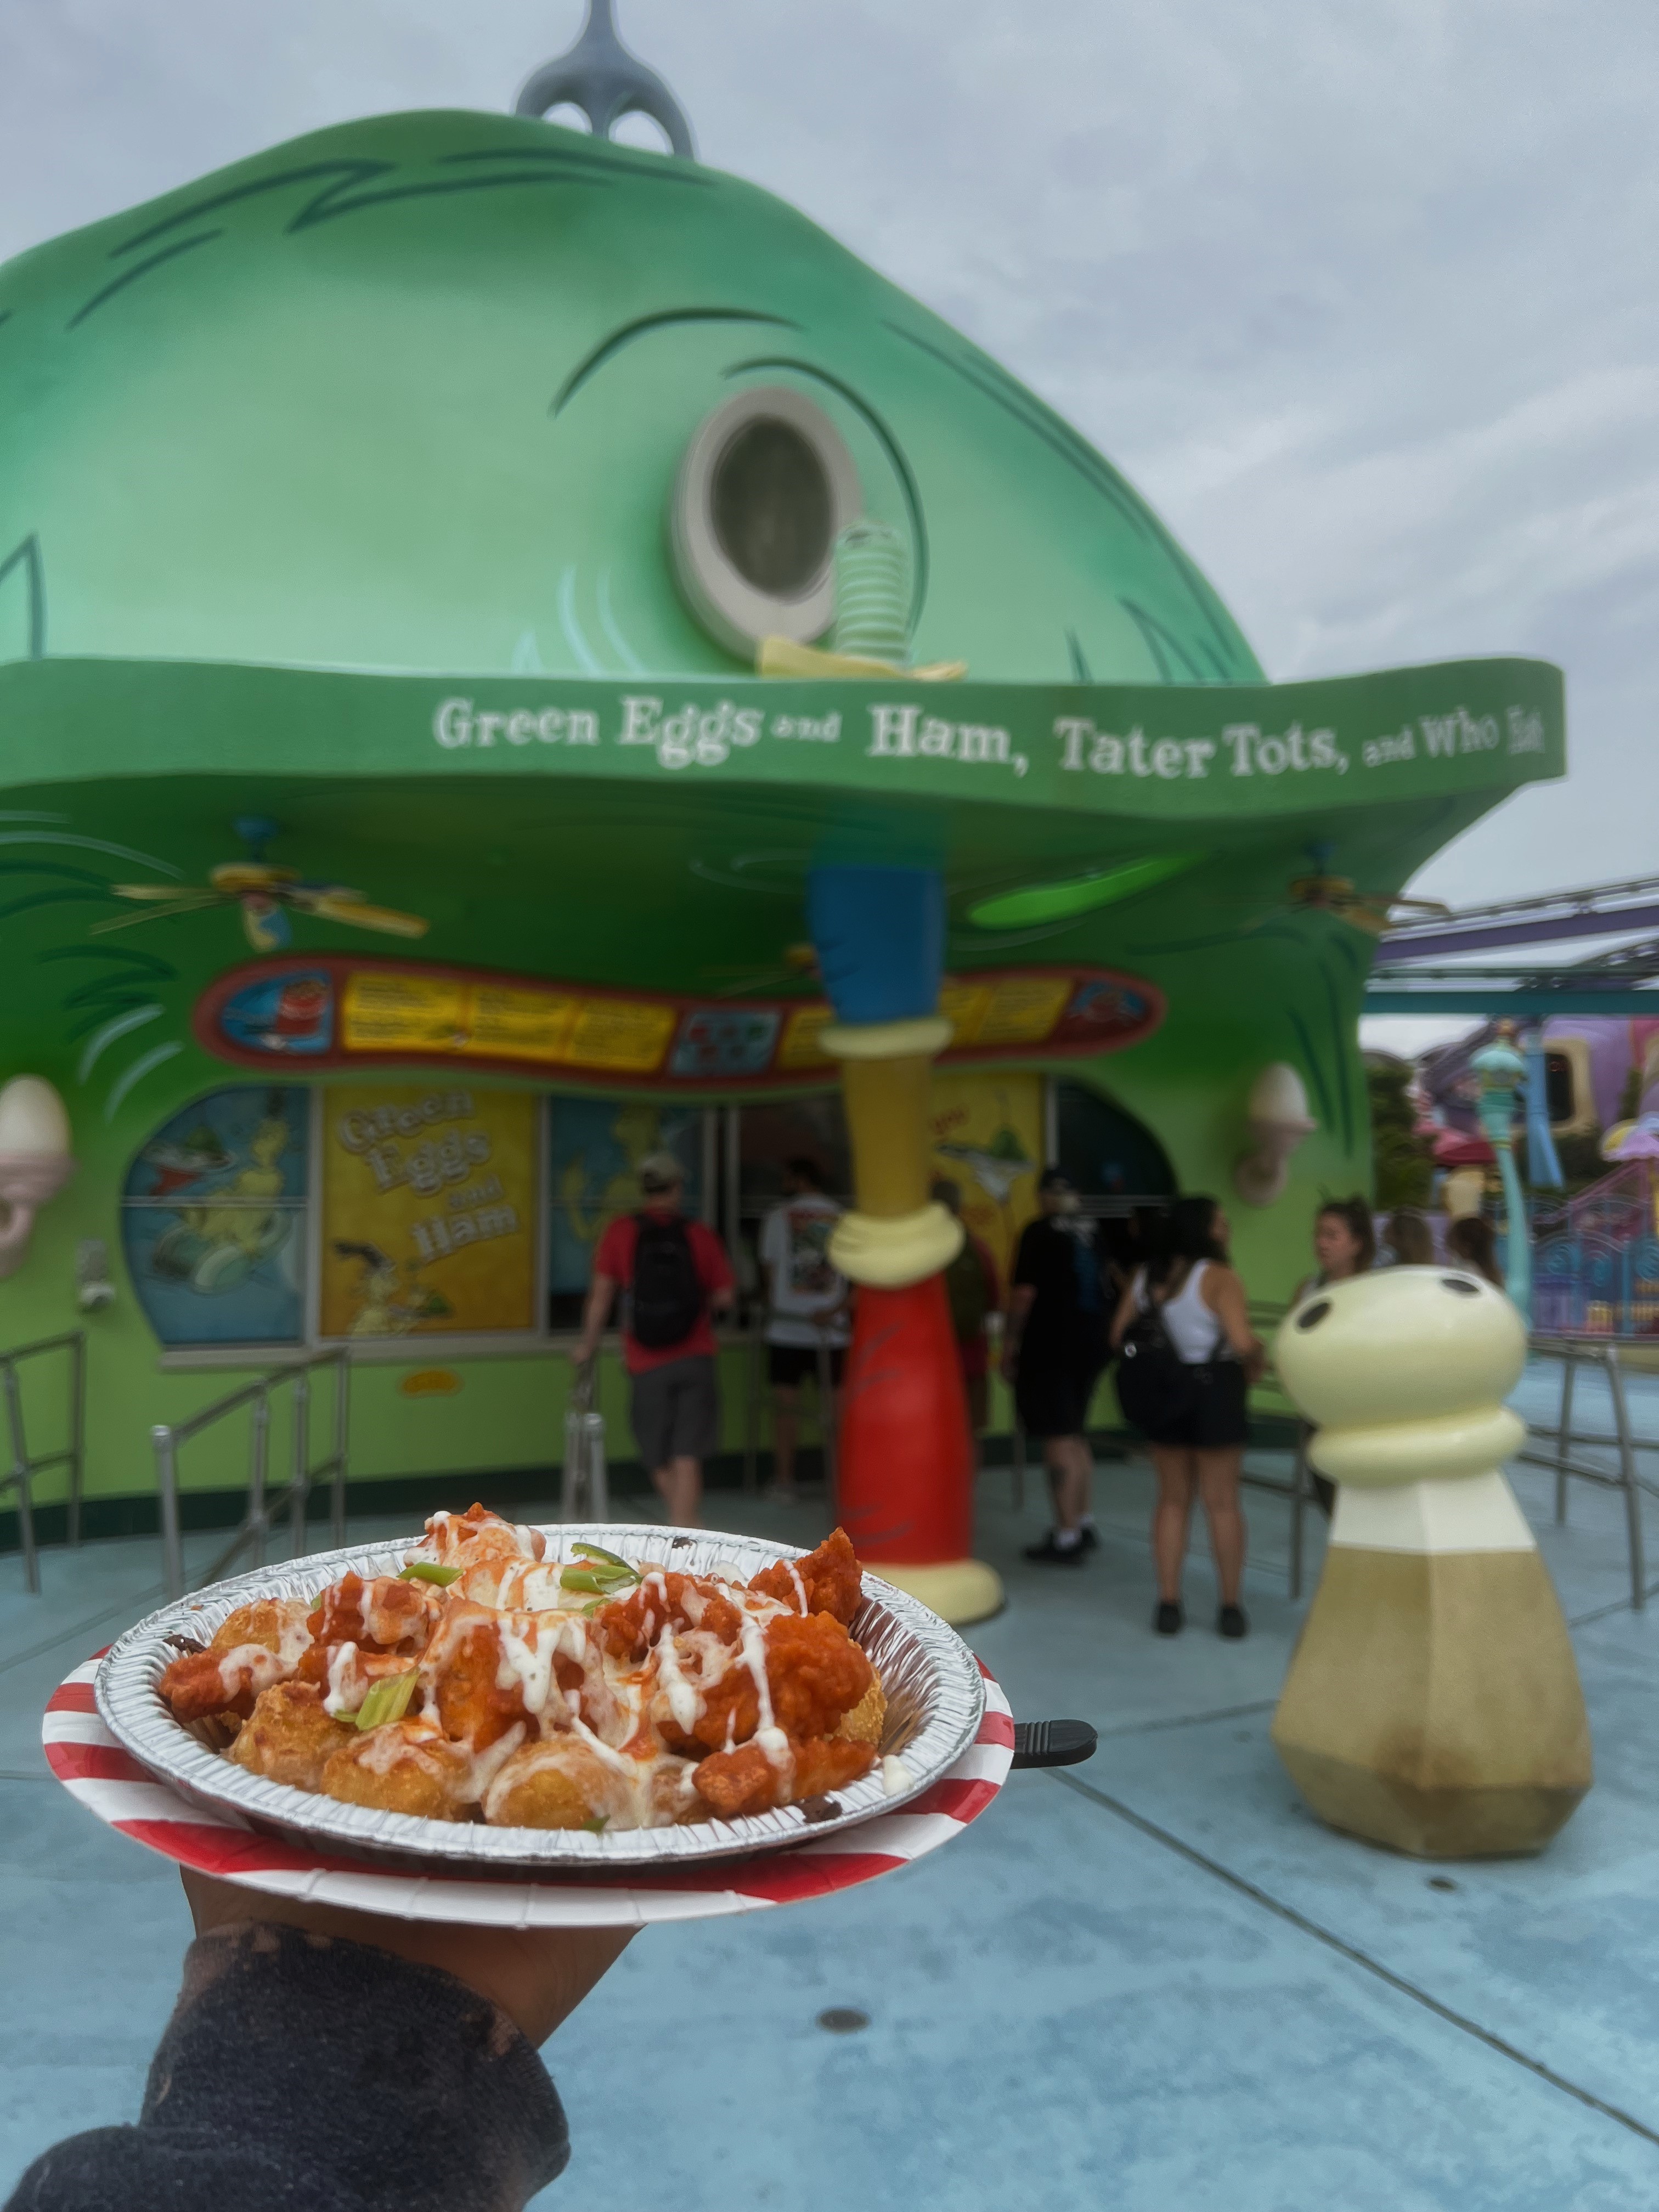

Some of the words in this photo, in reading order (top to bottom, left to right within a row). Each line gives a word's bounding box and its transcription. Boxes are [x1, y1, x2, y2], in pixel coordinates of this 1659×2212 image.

[436, 697, 601, 748] Green
[620, 695, 765, 769] Eggs
[772, 711, 842, 742] and
[867, 703, 1030, 778] Ham,
[1053, 715, 1215, 779] Tater
[1222, 720, 1350, 776] Tots,
[1362, 724, 1417, 767] and
[1419, 705, 1500, 758] Who
